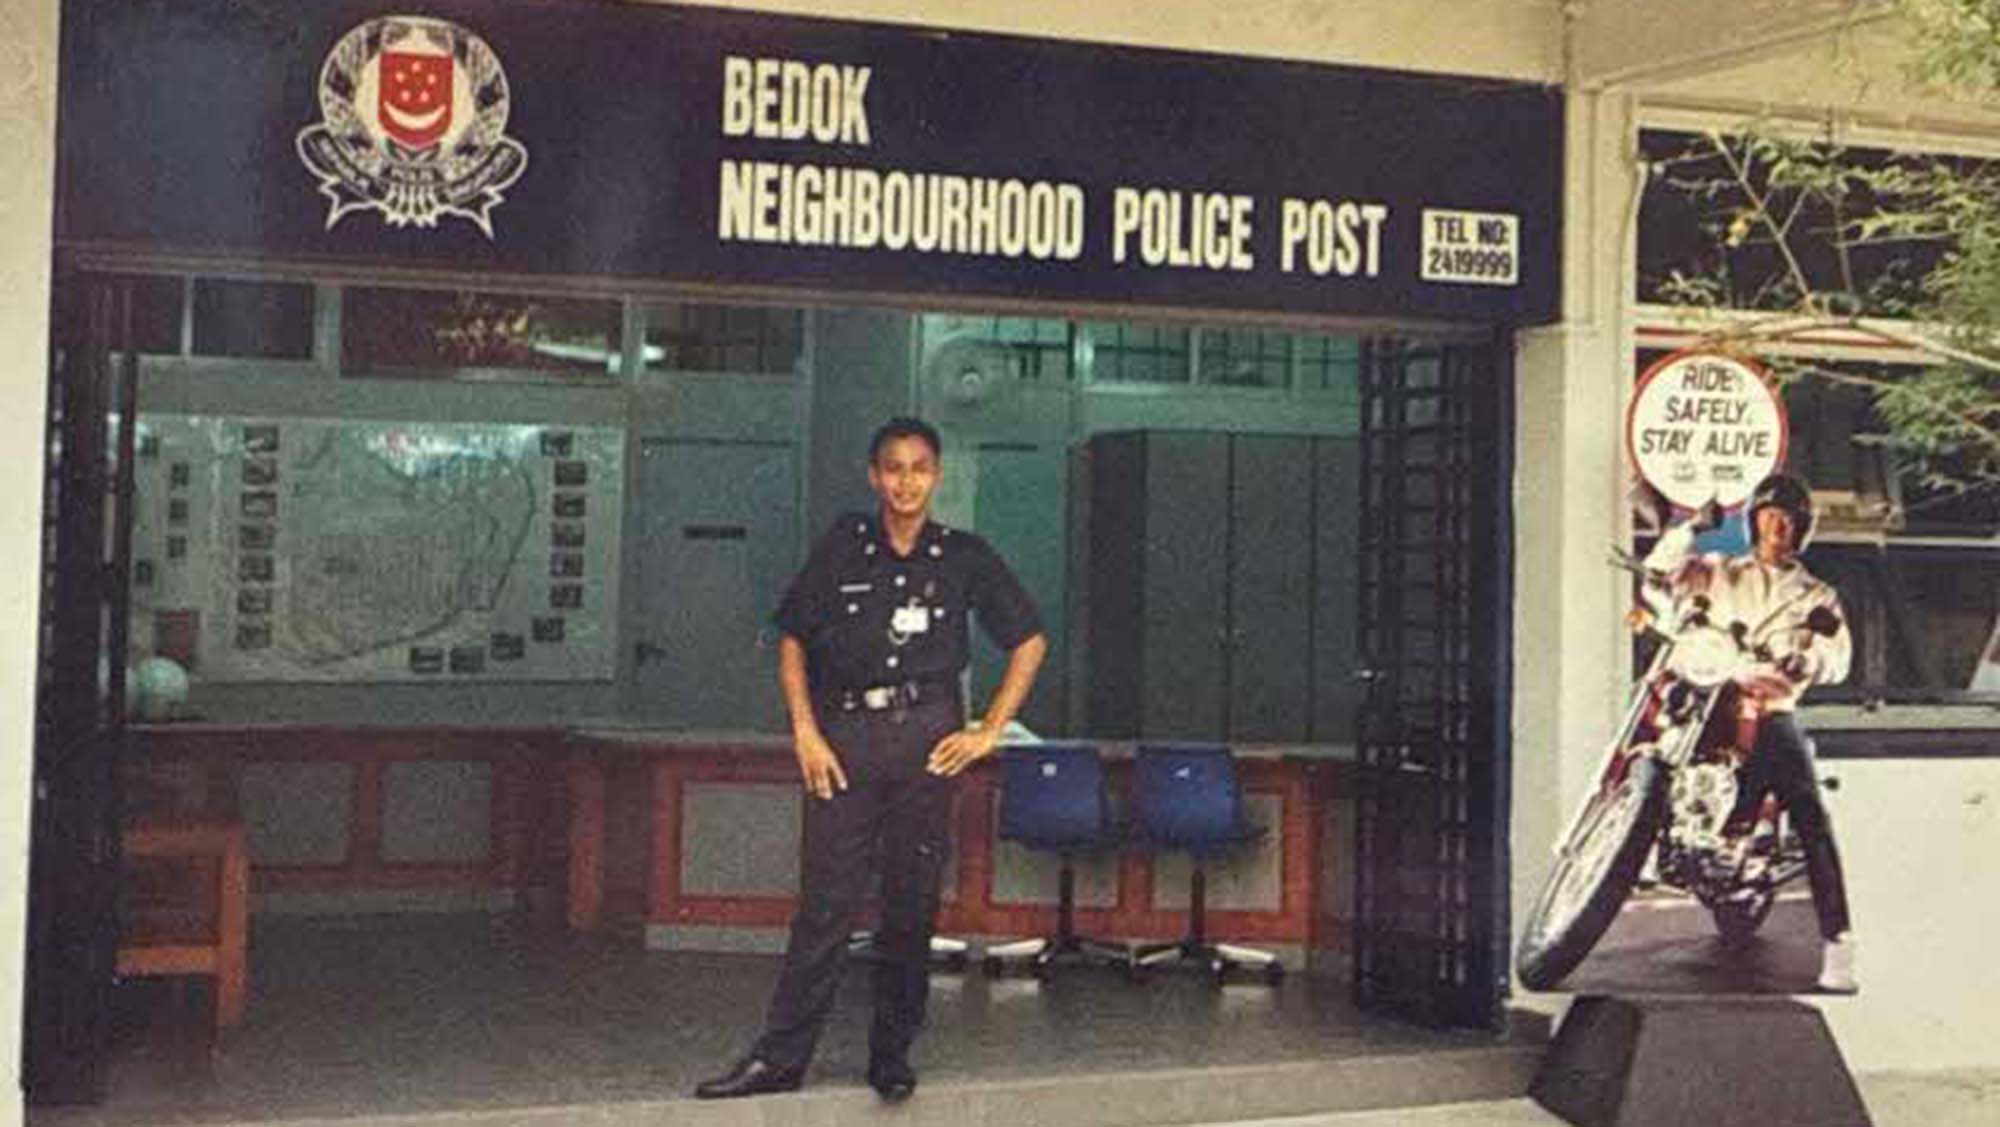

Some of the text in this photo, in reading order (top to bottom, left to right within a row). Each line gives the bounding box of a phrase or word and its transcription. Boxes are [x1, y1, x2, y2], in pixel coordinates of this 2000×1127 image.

[723, 56, 871, 145] BEDOK
[718, 159, 1387, 278] NEIGHBOURHOOD POLICE POST
[1433, 216, 1469, 243] TEL
[1428, 246, 1513, 278] 2419999
[1682, 364, 1734, 392] RIDE
[1640, 428, 1694, 454] STAY
